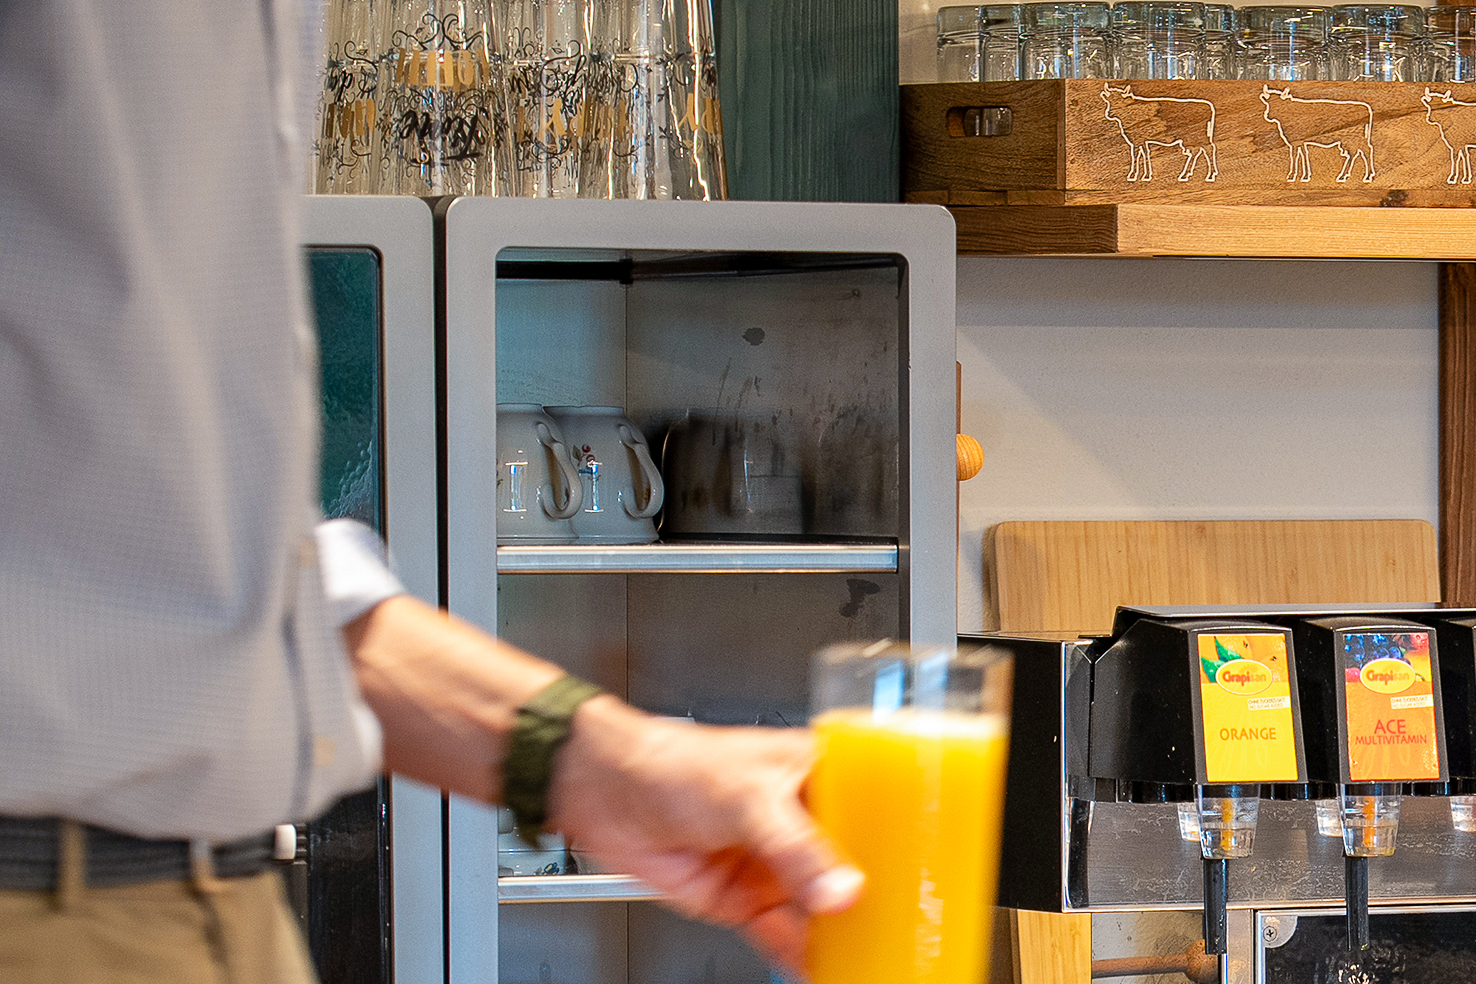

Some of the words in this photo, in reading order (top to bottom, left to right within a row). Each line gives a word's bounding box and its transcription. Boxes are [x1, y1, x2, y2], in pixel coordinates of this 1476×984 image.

[1219, 727, 1277, 741] ORANGE
[1373, 719, 1407, 735] ACE
[1354, 734, 1427, 746] MULTIVITAMIN
